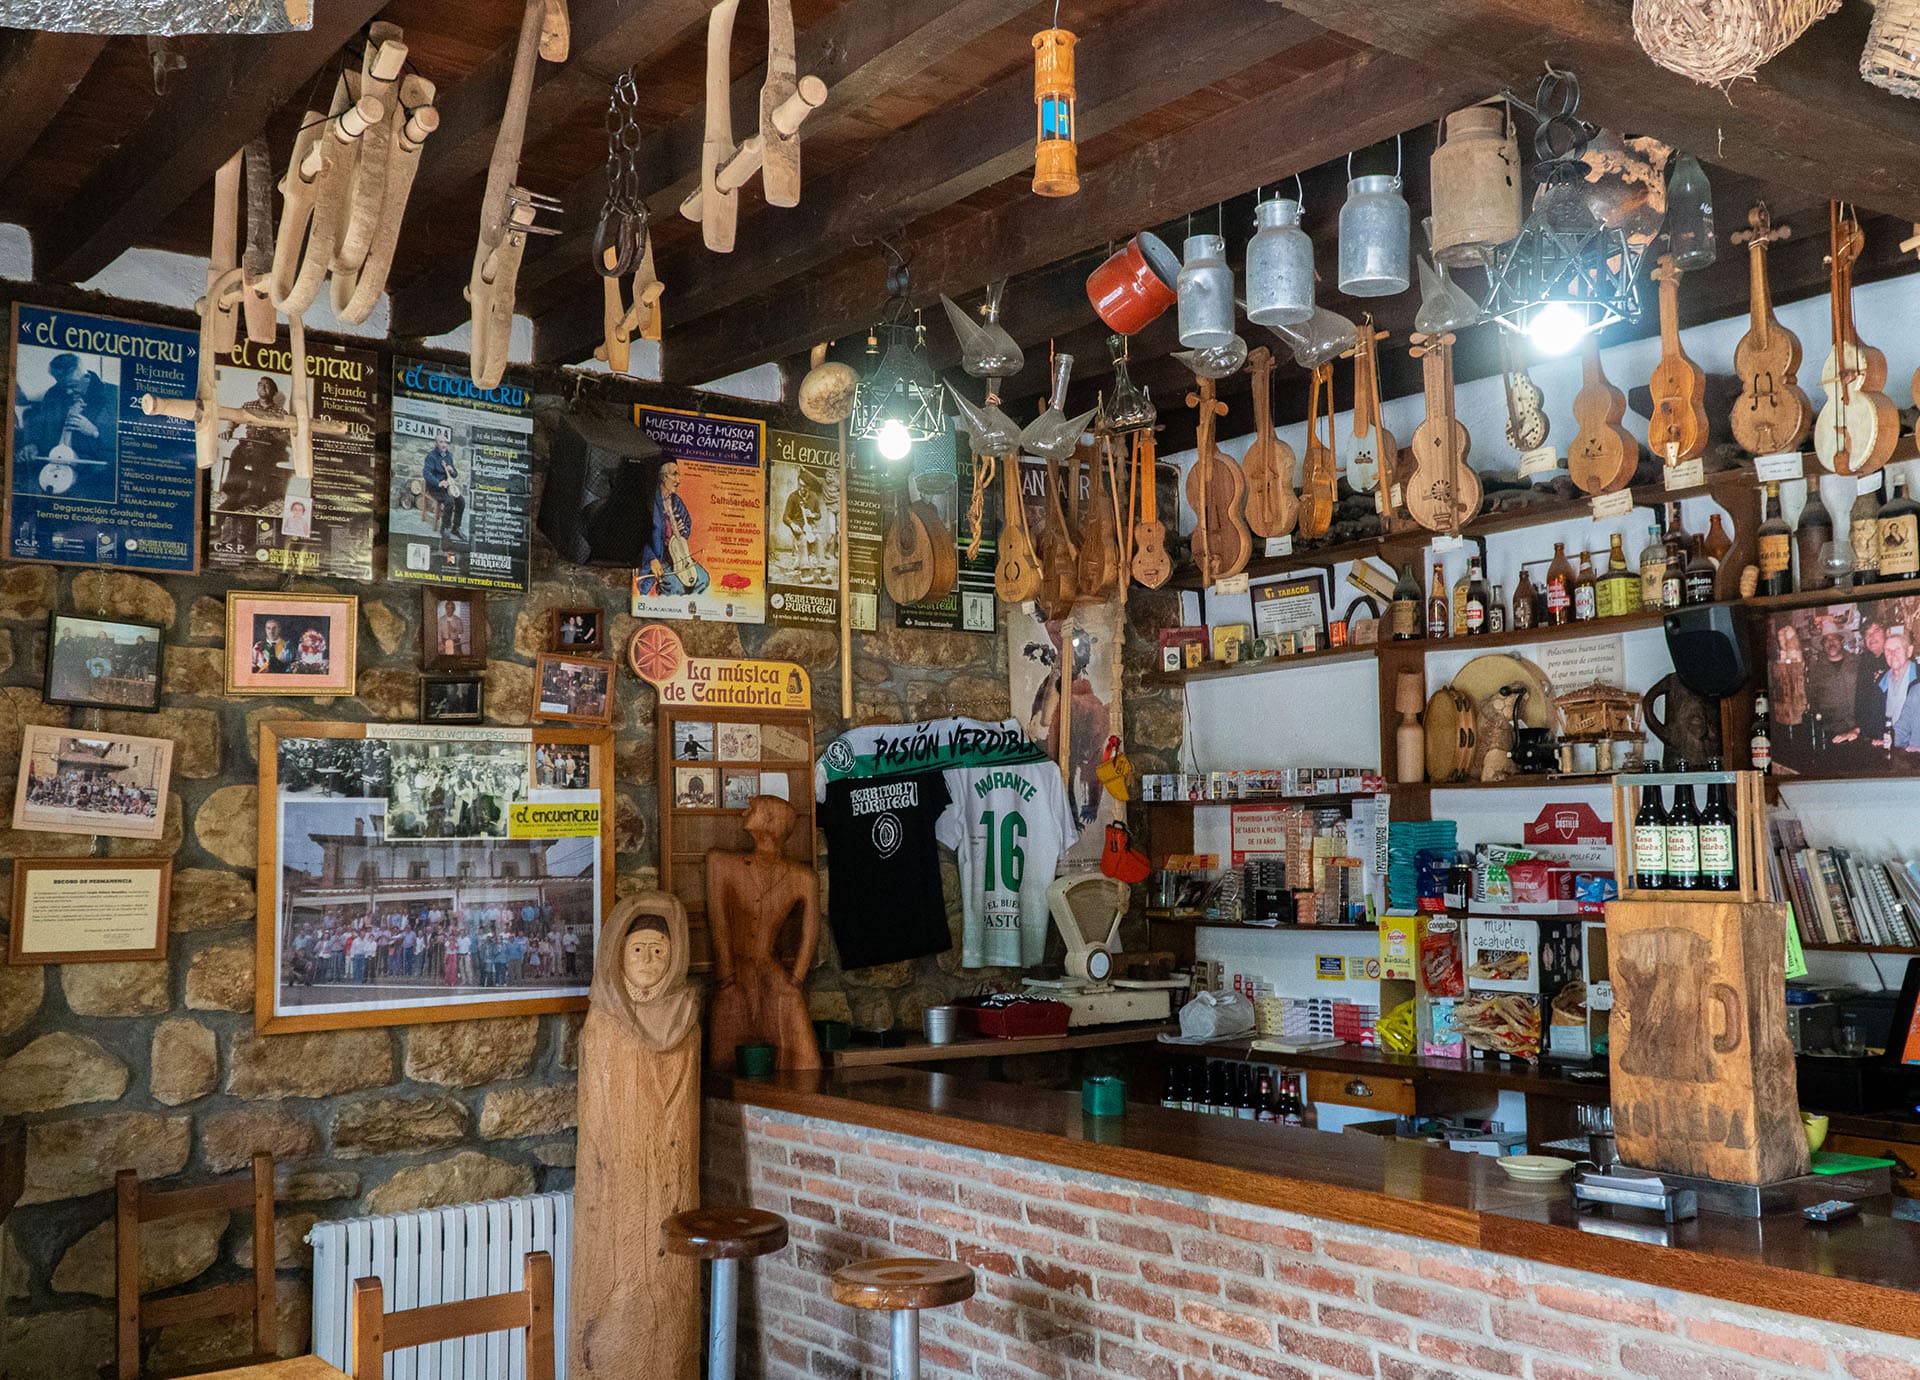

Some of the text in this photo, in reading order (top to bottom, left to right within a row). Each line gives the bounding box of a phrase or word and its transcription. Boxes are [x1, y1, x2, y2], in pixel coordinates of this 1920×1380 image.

[135, 363, 185, 380] Pejanda
[323, 382, 367, 398] Pejanda
[645, 416, 755, 440] MUESTRA DE MÚSICA
[645, 429, 694, 446] POPULAR
[696, 436, 753, 452] CÁNTABRA
[53, 503, 158, 520] Degustación Gratuita de
[71, 513, 115, 524] Ecológica
[117, 517, 129, 525] de
[130, 519, 173, 530] Cantabria
[1277, 585, 1310, 598] TABACOS
[1580, 656, 1587, 664] de
[687, 660, 781, 685] La música
[663, 681, 782, 705] de Cantabria
[873, 723, 941, 770] PASIÓN
[974, 772, 1038, 803] MORANTE
[1243, 826, 1262, 834] TABACO
[1263, 837, 1276, 845] AÑOS
[979, 810, 1028, 893] 16
[1428, 922, 1457, 931] conguitos
[1472, 935, 1526, 950] cacahuetes
